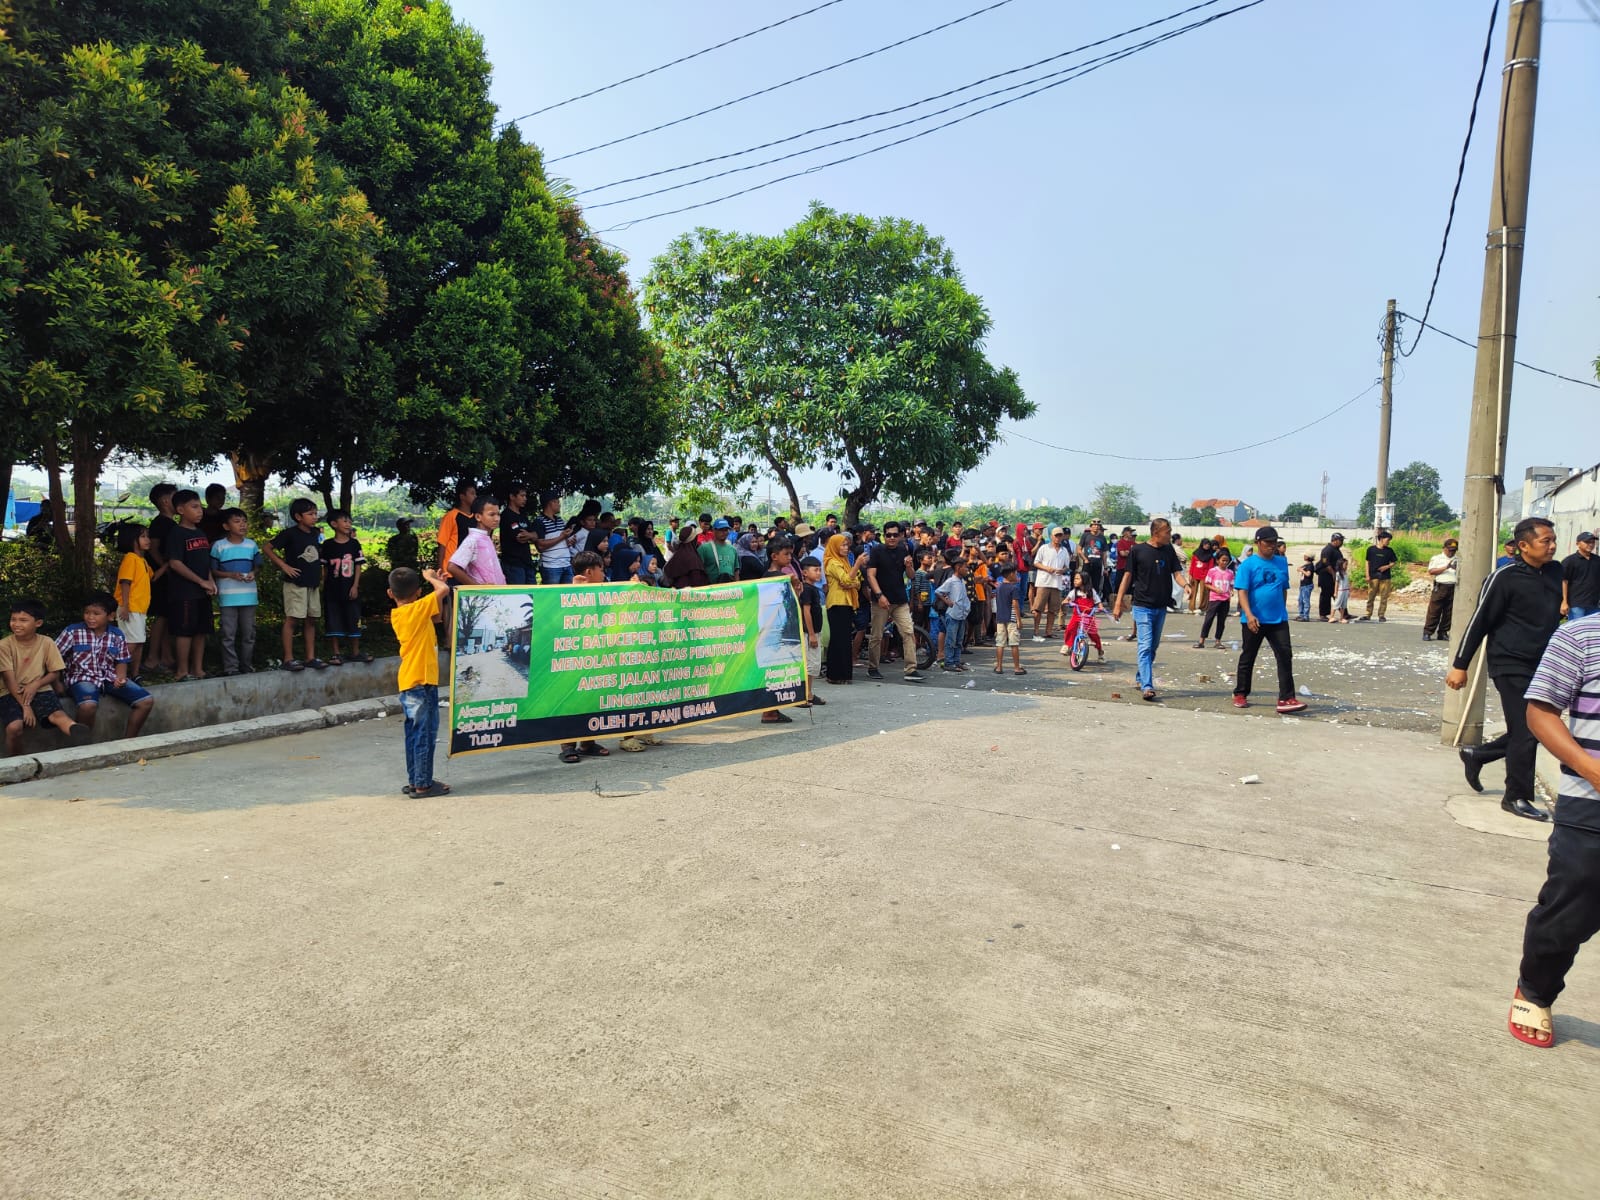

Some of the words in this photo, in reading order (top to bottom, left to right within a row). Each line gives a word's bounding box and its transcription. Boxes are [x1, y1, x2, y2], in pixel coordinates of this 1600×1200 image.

[560, 592, 596, 608] KAMI
[599, 590, 679, 606] MASYARAKAT
[553, 637, 580, 652] KEC
[658, 629, 688, 643] KOTA
[688, 624, 746, 640] TANGERANG
[551, 653, 617, 673] MENOLAK
[619, 650, 659, 666] KERAS
[661, 648, 688, 663] ATAS
[689, 641, 746, 659] PENUTUPAN
[577, 673, 618, 691] AKSES
[618, 670, 660, 689] JALAN
[662, 667, 691, 682] YANG
[692, 663, 713, 678] ADA
[599, 687, 682, 710] LINGKUNGAN
[683, 683, 710, 699] KAMI
[775, 691, 797, 702] Tutup
[456, 717, 505, 735] Sebelum
[505, 714, 518, 728] di
[588, 714, 626, 731] OLEH
[628, 711, 649, 727] PT.
[651, 706, 682, 724] PANJI
[682, 701, 717, 719] GRAHA
[469, 733, 503, 747] Tutup
